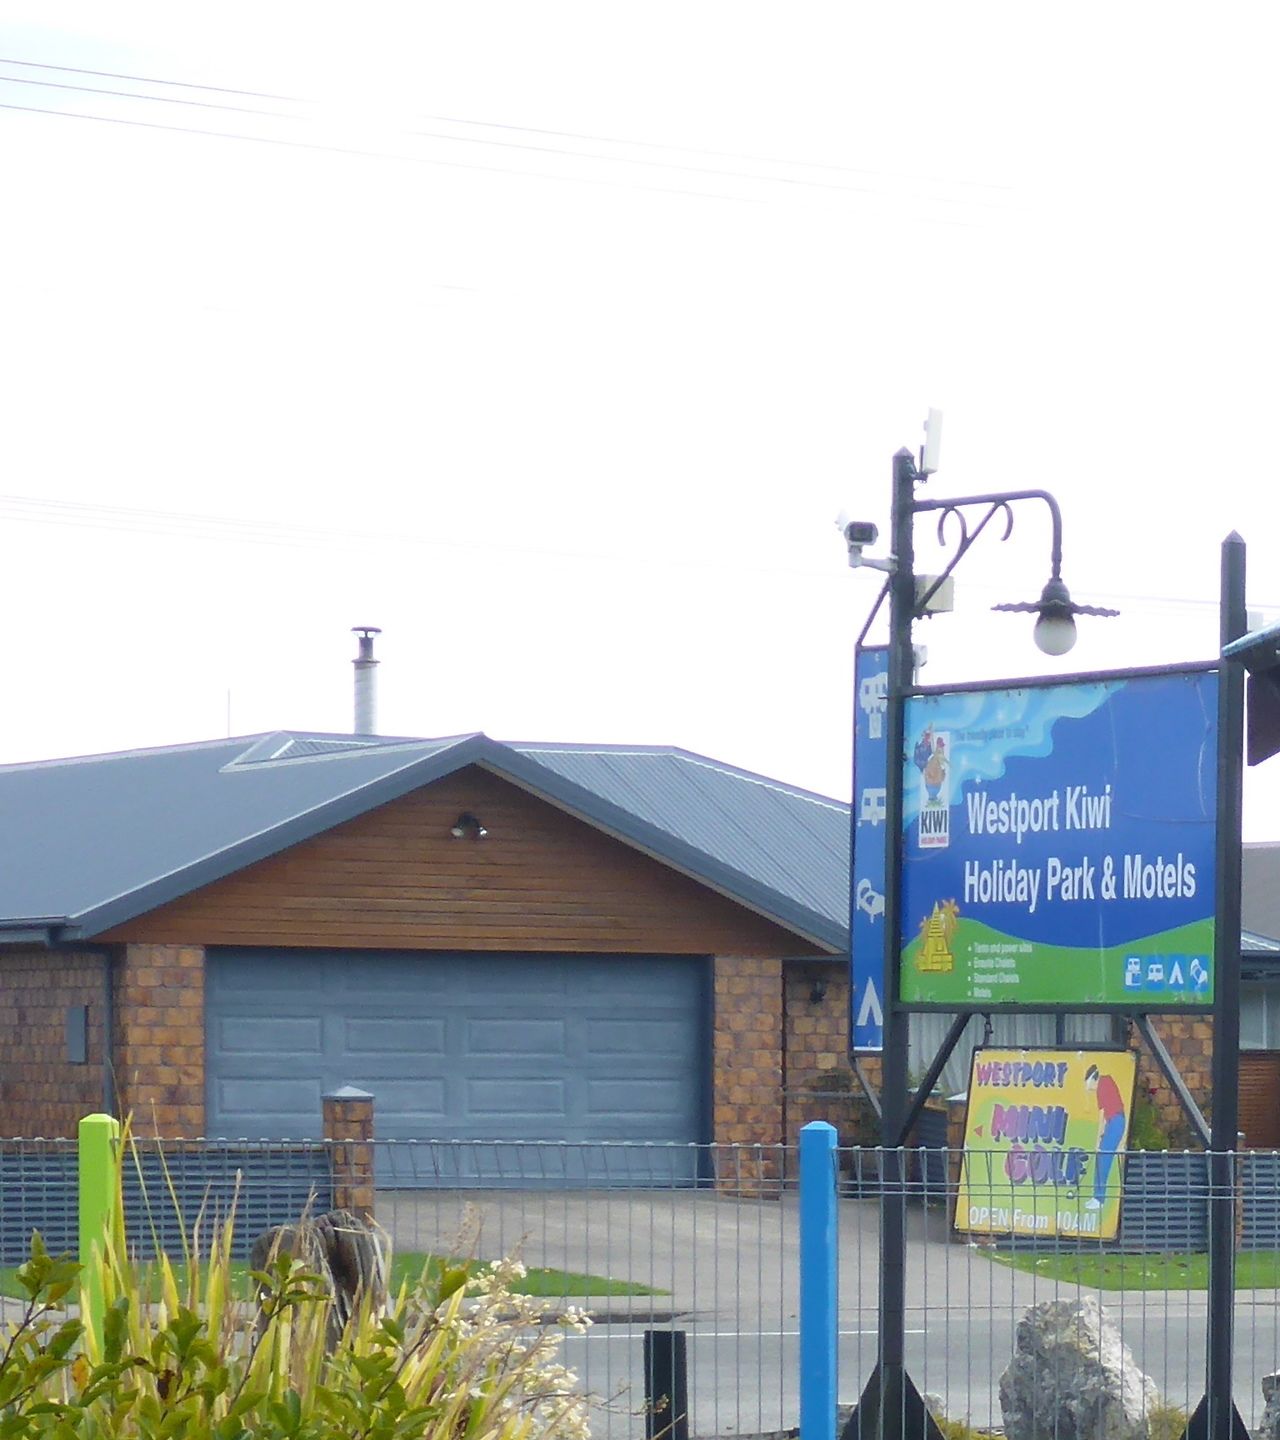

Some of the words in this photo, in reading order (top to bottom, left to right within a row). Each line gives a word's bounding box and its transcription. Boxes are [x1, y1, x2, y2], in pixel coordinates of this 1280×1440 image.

[921, 810, 947, 834] KIWI
[967, 790, 1059, 844] Westport
[1066, 785, 1110, 829] Kiwi
[965, 859, 1040, 913] Holiday
[1047, 856, 1095, 900] Park
[1101, 855, 1117, 900] &
[1124, 852, 1196, 898] Motels
[976, 1061, 1068, 1088] WESTPORT
[991, 1103, 1068, 1145] MINI
[1005, 1144, 1089, 1186] GOLF
[970, 1206, 1009, 1227] OPEN
[1013, 1208, 1048, 1229] From
[1057, 1211, 1096, 1232] 10AM
